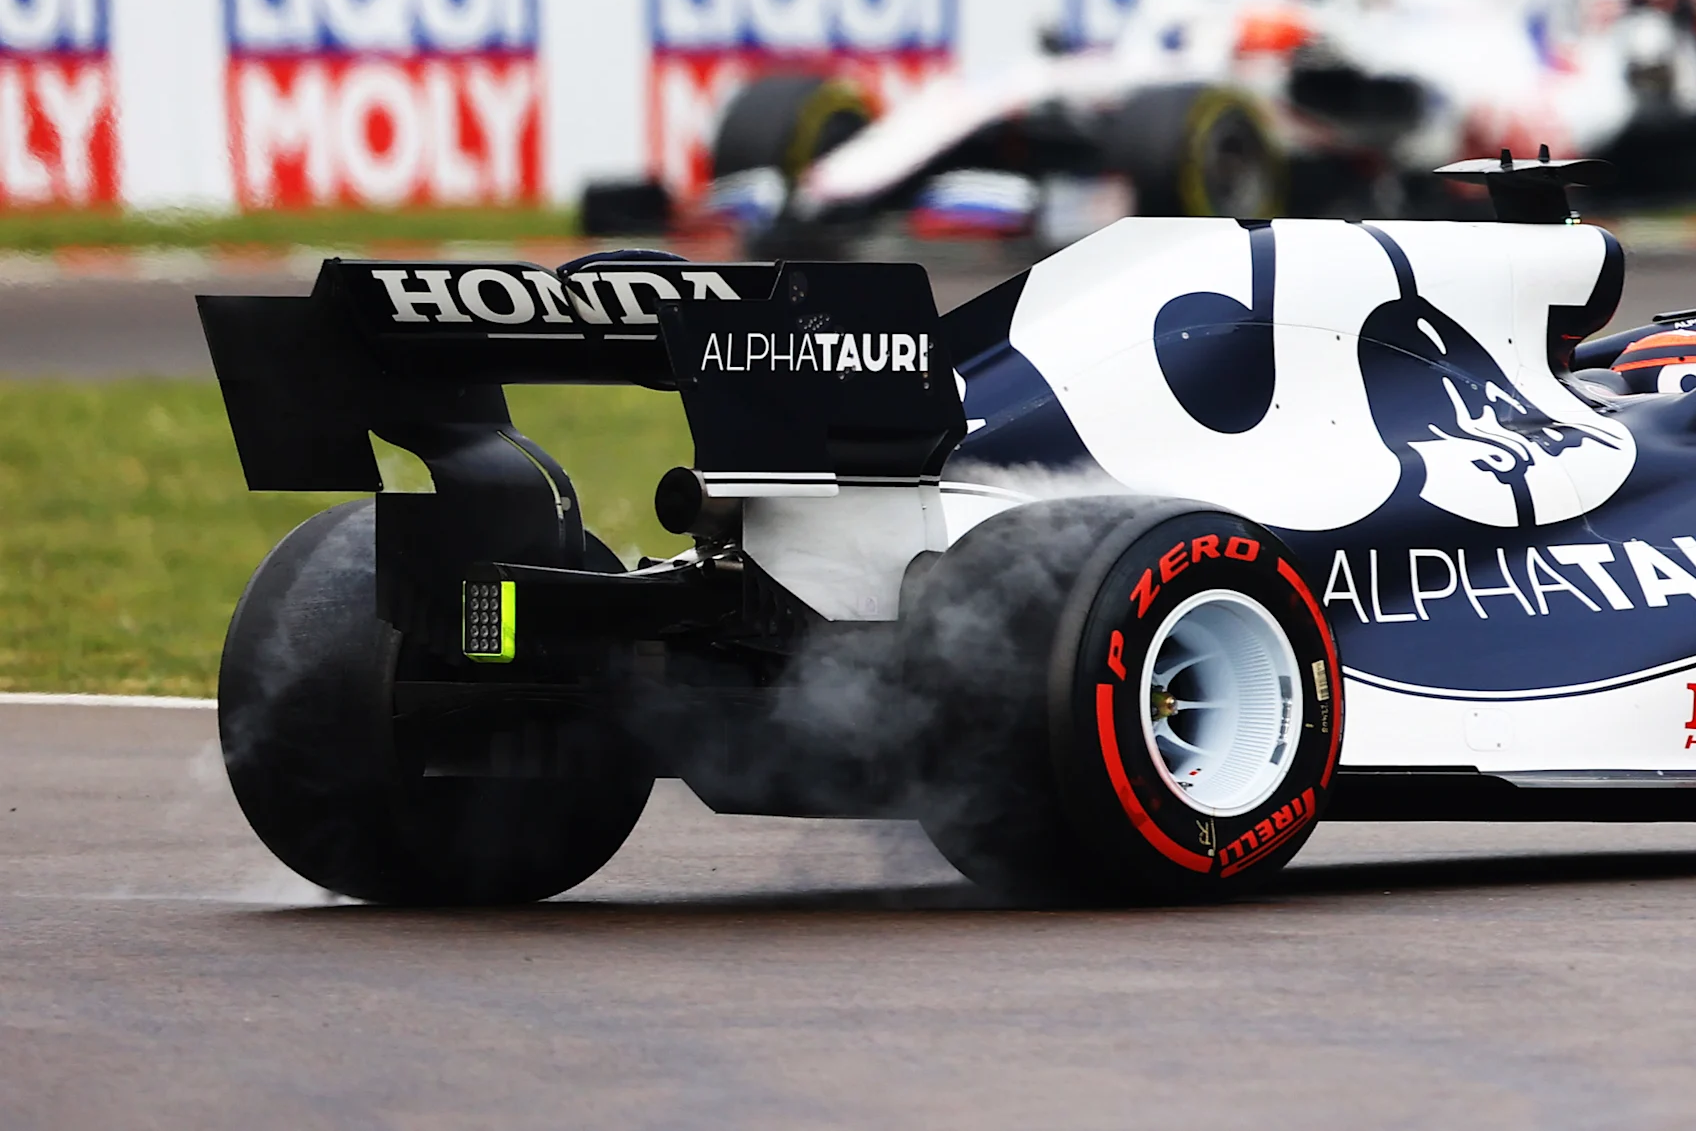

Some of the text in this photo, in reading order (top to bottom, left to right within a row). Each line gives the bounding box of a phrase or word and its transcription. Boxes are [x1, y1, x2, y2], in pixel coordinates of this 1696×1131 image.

[239, 62, 532, 198] MOLY
[700, 332, 930, 372] ALPHATAURI
[1108, 533, 1261, 681] P ZERO
[1218, 786, 1316, 879] PIRELLI
